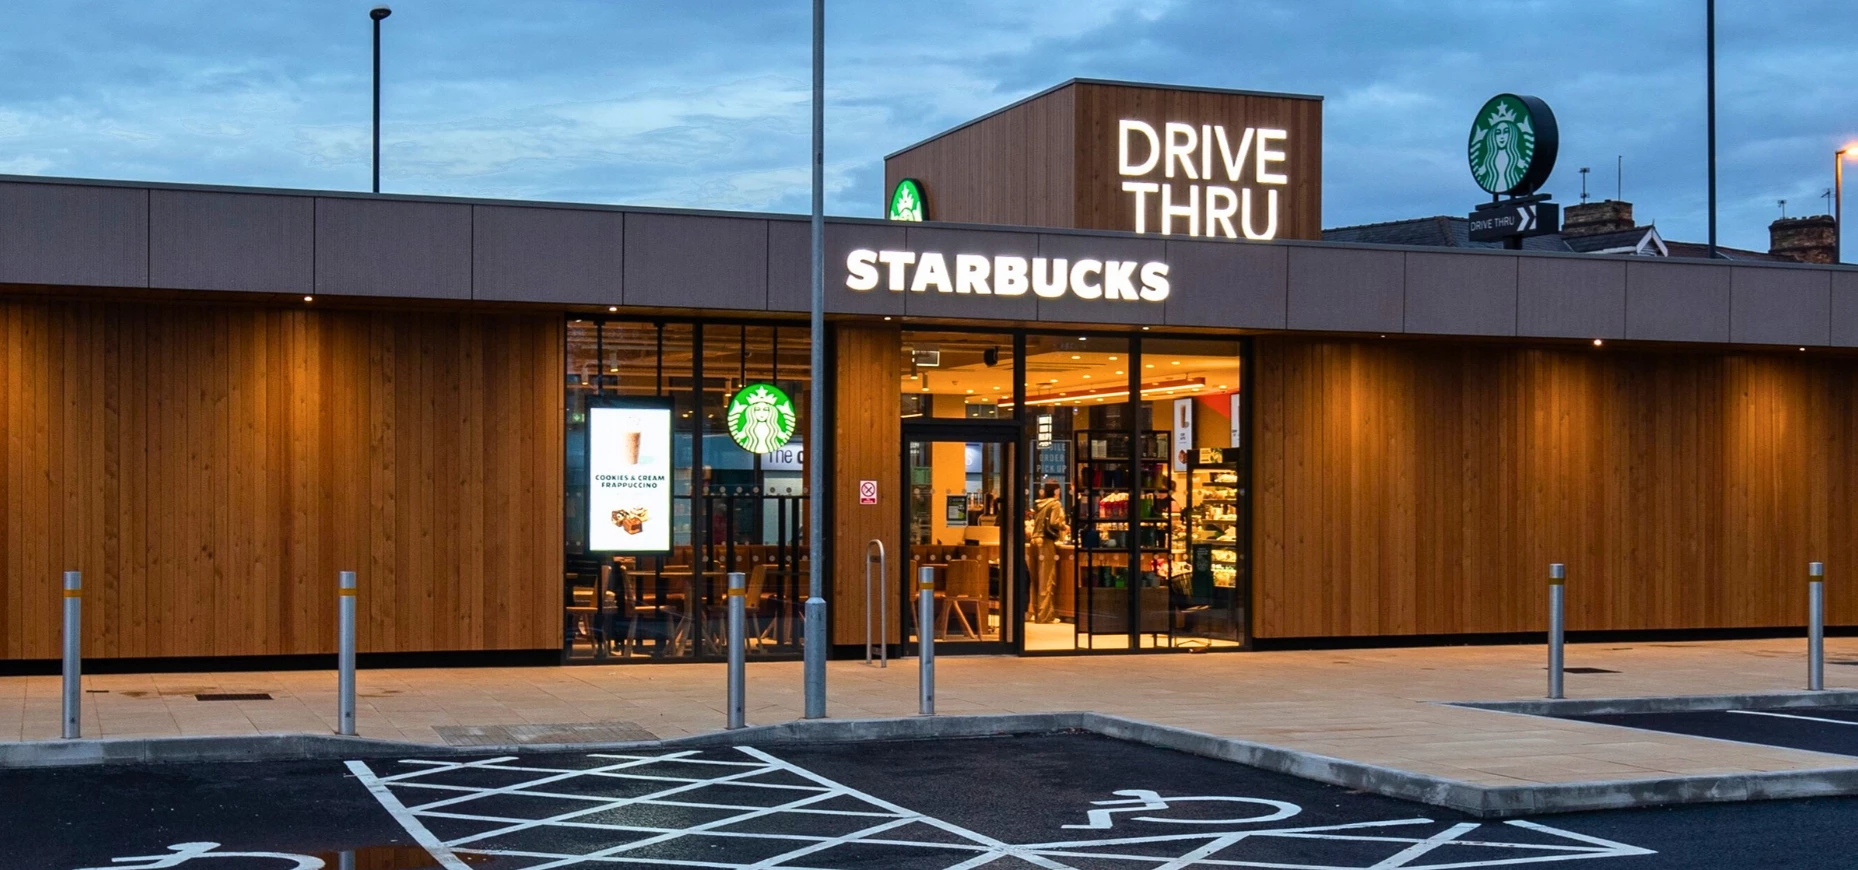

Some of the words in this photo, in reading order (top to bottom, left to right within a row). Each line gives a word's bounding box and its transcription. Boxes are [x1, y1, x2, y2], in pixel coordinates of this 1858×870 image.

[1119, 119, 1288, 185] DRIVE
[1122, 181, 1278, 241] THRU
[1470, 219, 1493, 232] DRIVE
[1494, 216, 1515, 228] THRU
[846, 249, 1171, 302] STARBUCKS
[1039, 454, 1065, 462] ORDER
